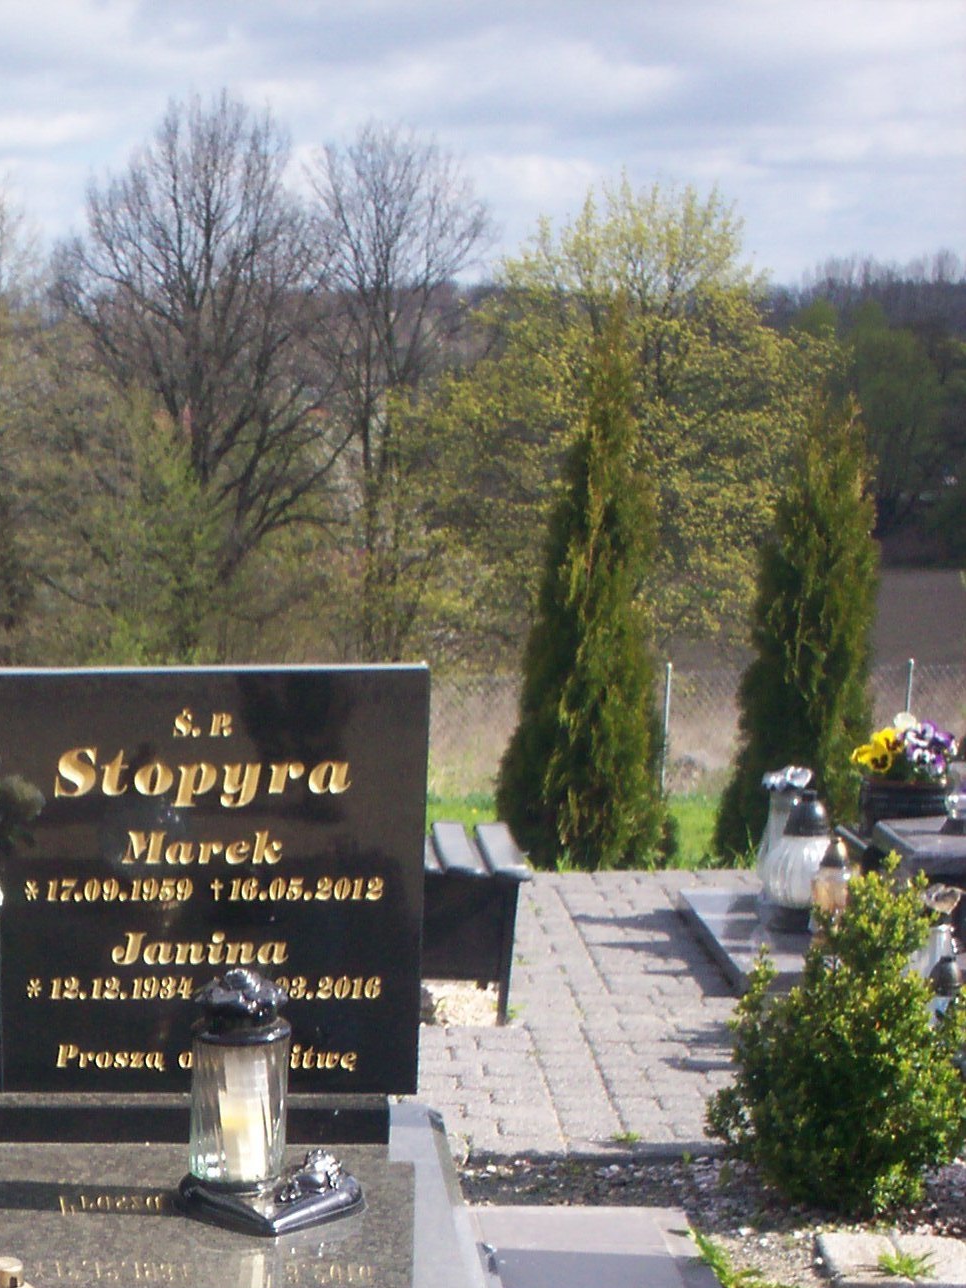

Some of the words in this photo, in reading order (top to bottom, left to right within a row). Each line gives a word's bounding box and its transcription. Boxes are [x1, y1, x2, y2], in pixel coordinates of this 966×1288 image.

[54, 746, 352, 808] Stopyra
[121, 829, 283, 866] Marek
[46, 877, 194, 902] 17.09.1959
[111, 930, 289, 966] Janina
[49, 975, 194, 1000] 12.12.1934
[55, 1043, 166, 1072] Proszą
